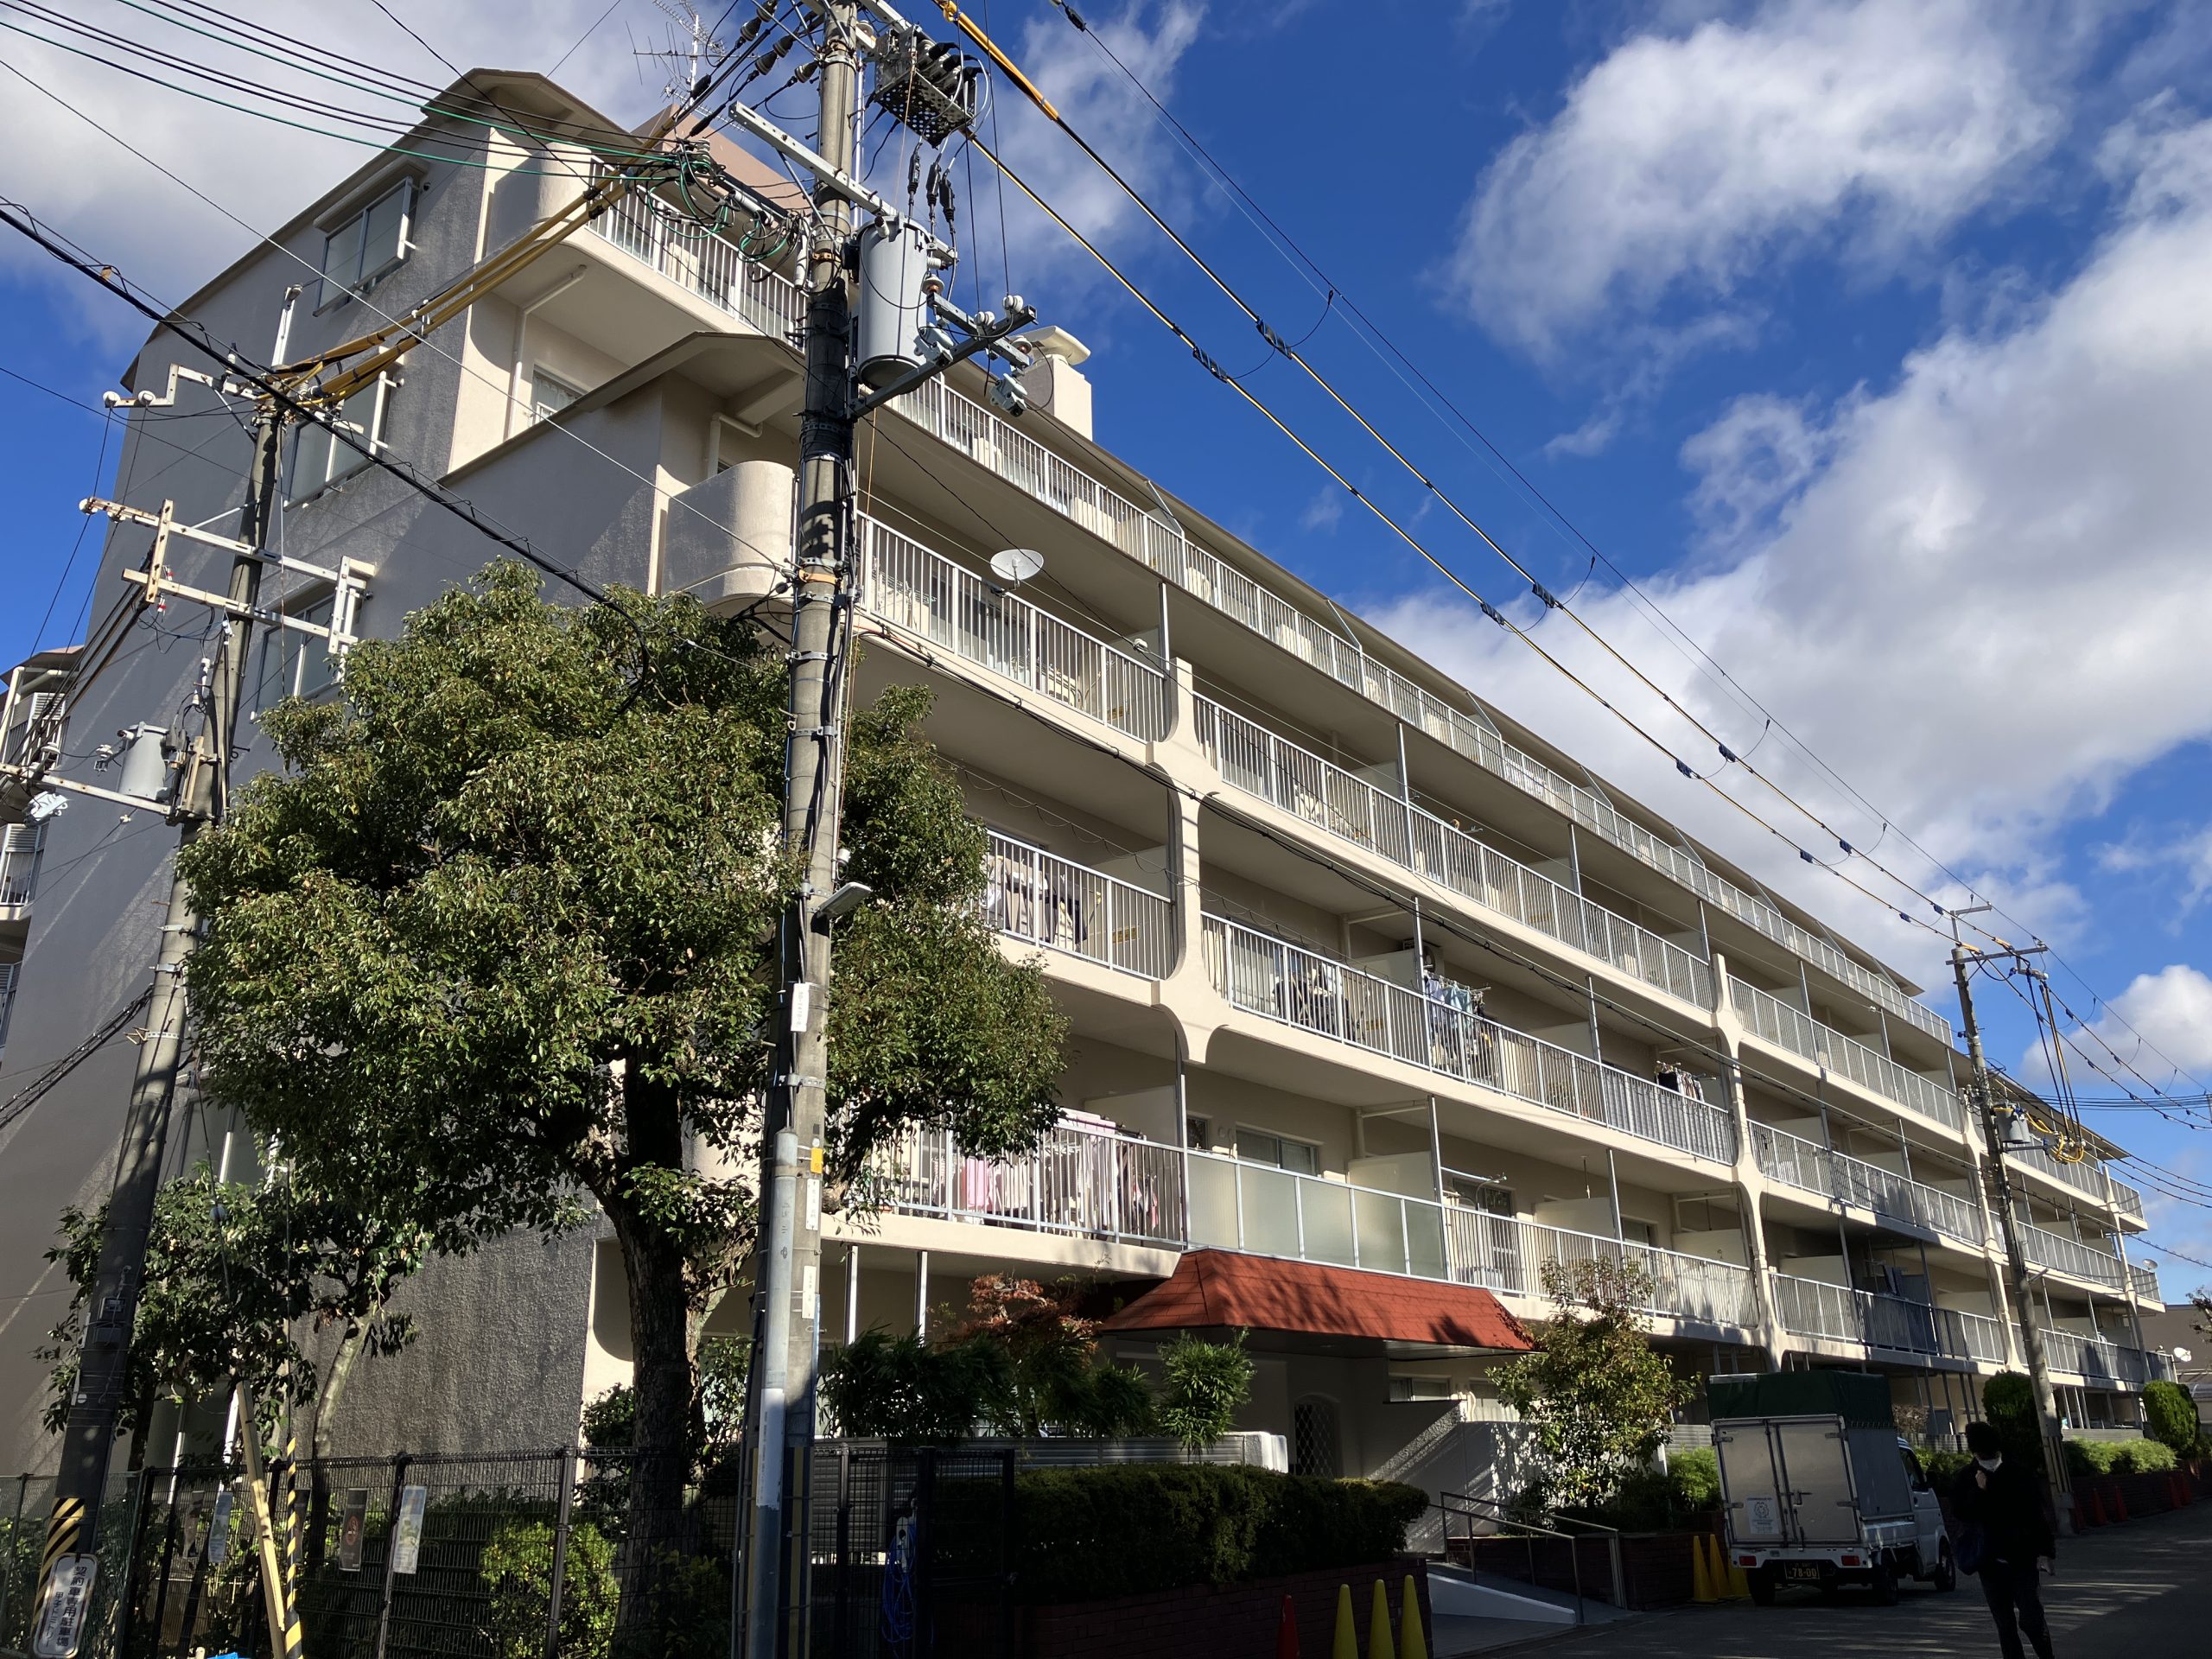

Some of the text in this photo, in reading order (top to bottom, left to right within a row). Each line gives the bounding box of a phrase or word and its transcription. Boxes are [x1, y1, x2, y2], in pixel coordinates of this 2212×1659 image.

[55, 1566, 87, 1647] 契約車専用駐車場
